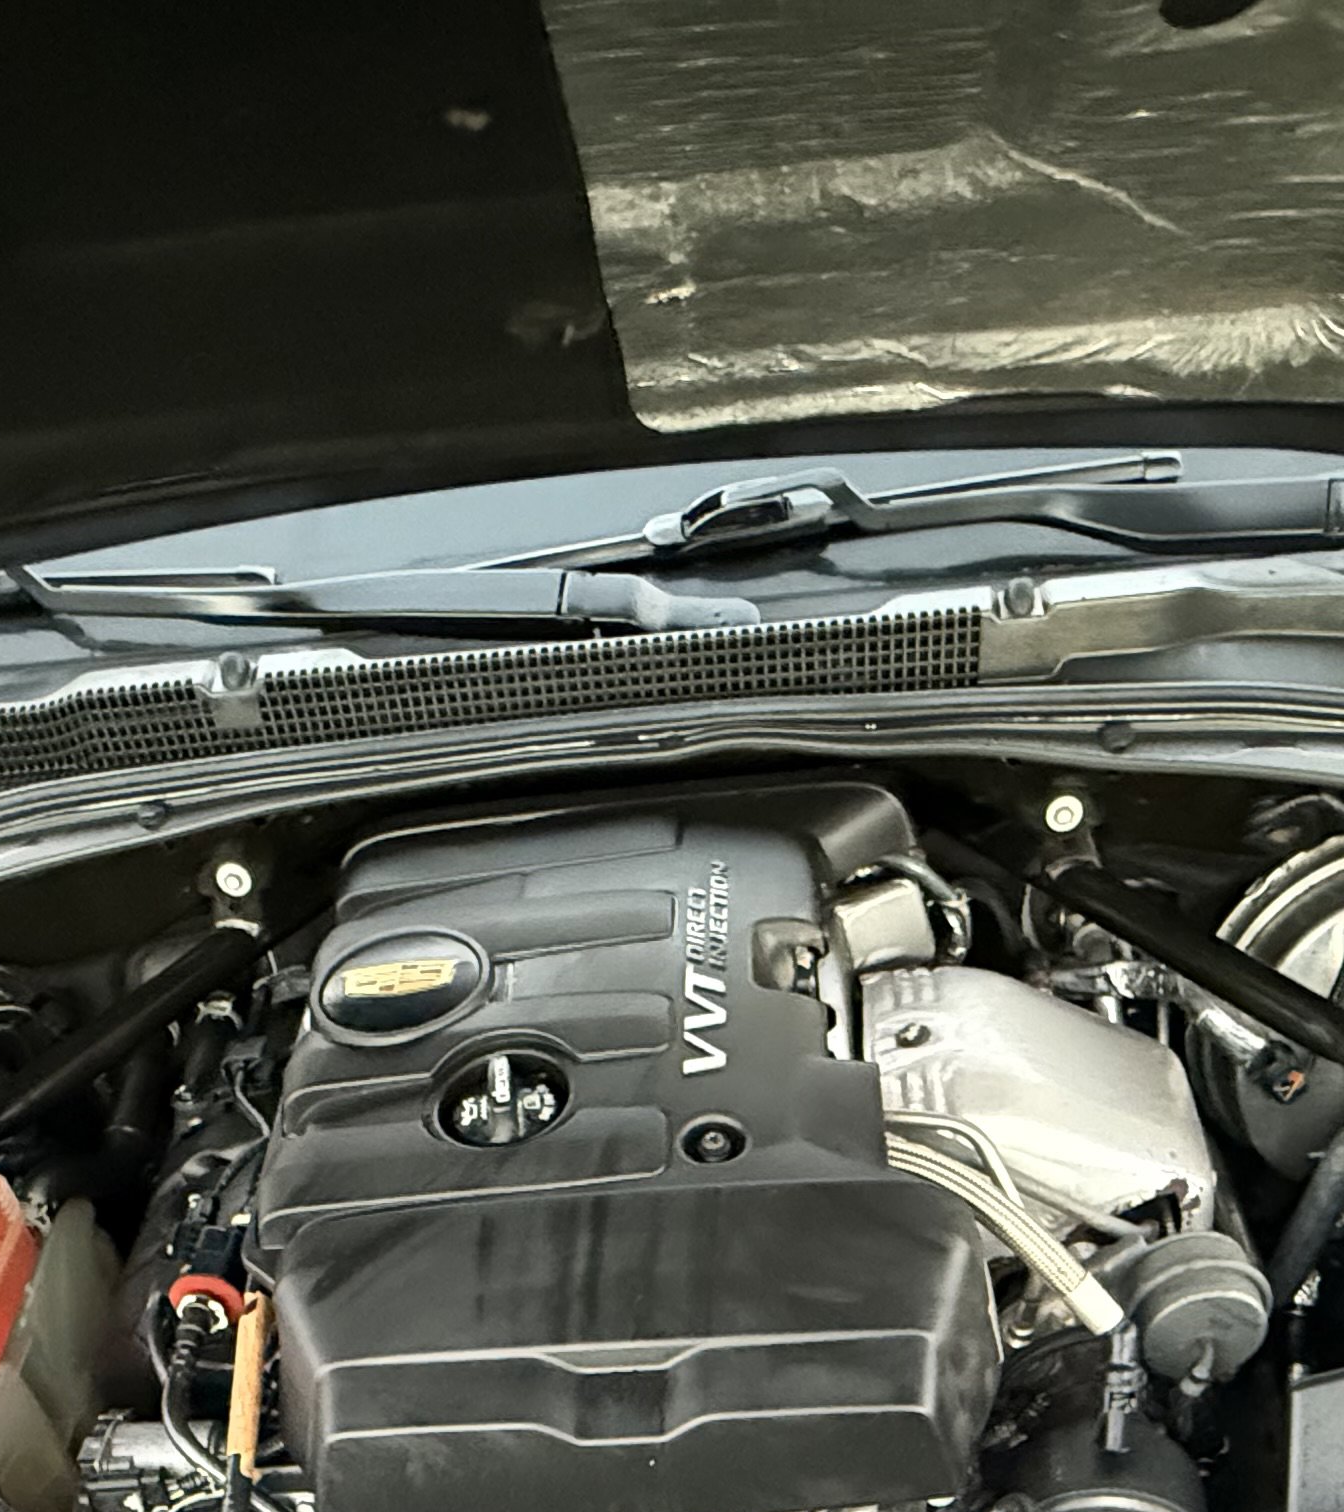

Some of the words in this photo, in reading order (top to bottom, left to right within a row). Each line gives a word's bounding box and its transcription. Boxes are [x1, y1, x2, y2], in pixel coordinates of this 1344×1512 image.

[686, 887, 707, 961] DIRECT
[709, 860, 729, 967] INJECTION
[682, 962, 727, 1075] VVT
